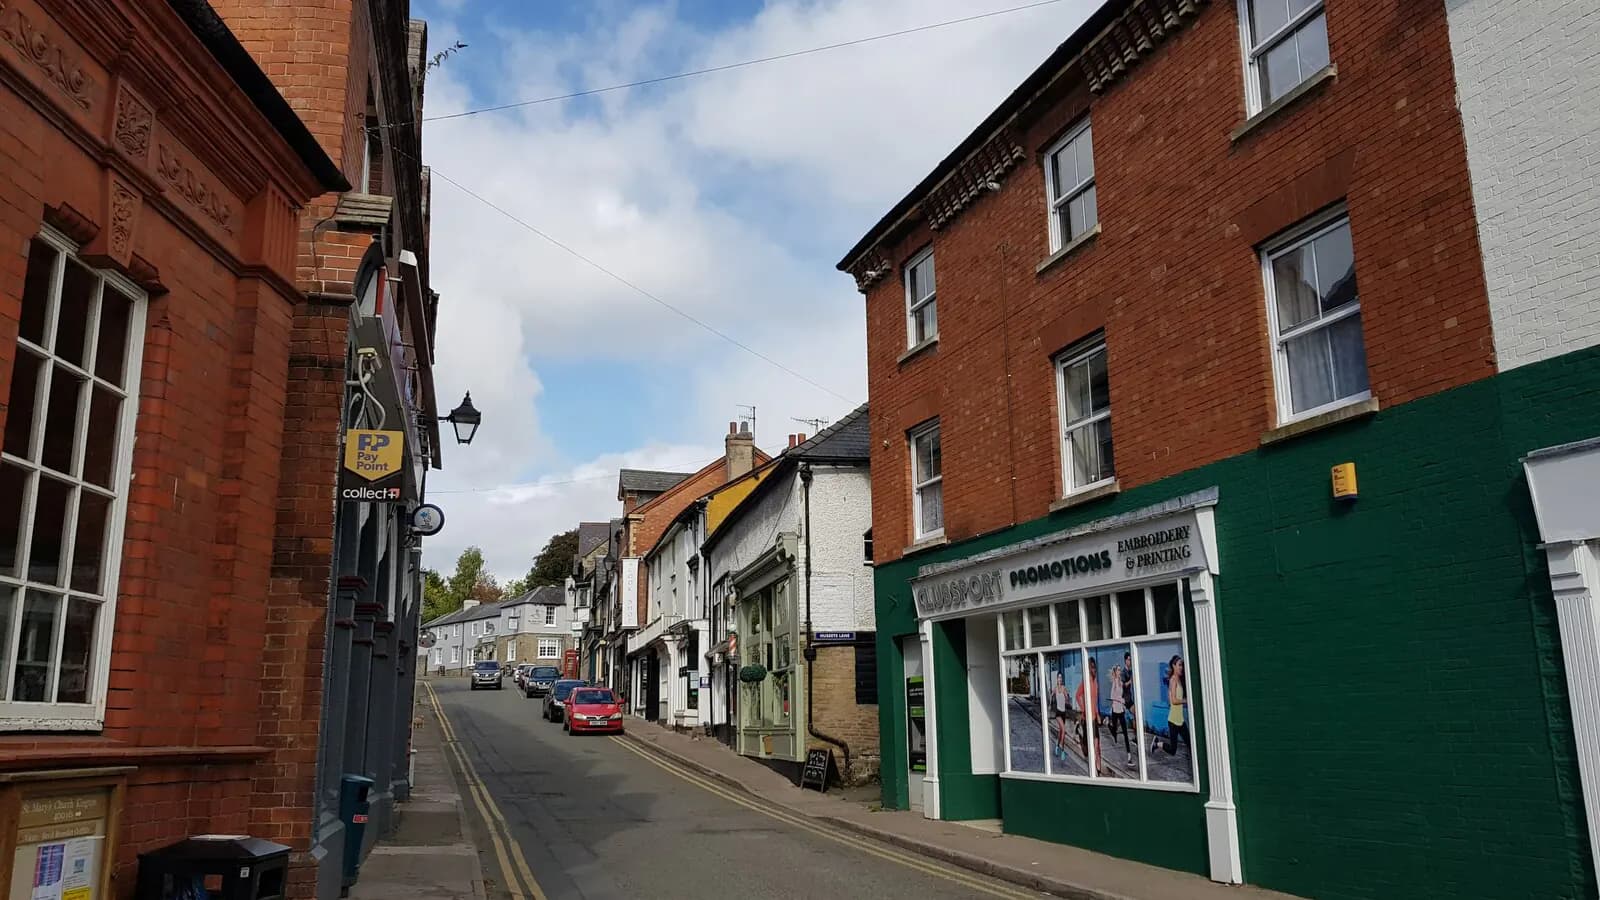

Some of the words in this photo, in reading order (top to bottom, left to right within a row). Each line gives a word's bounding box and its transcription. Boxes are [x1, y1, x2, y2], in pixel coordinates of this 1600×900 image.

[357, 461, 389, 471] Point
[358, 452, 378, 462] Pay
[1117, 525, 1190, 553] EMBROIDERY
[1126, 557, 1135, 569] &
[1137, 545, 1191, 568] PRINTING
[917, 568, 1003, 611] CLUBSPORT
[1010, 550, 1112, 587] PROMOTIONS
